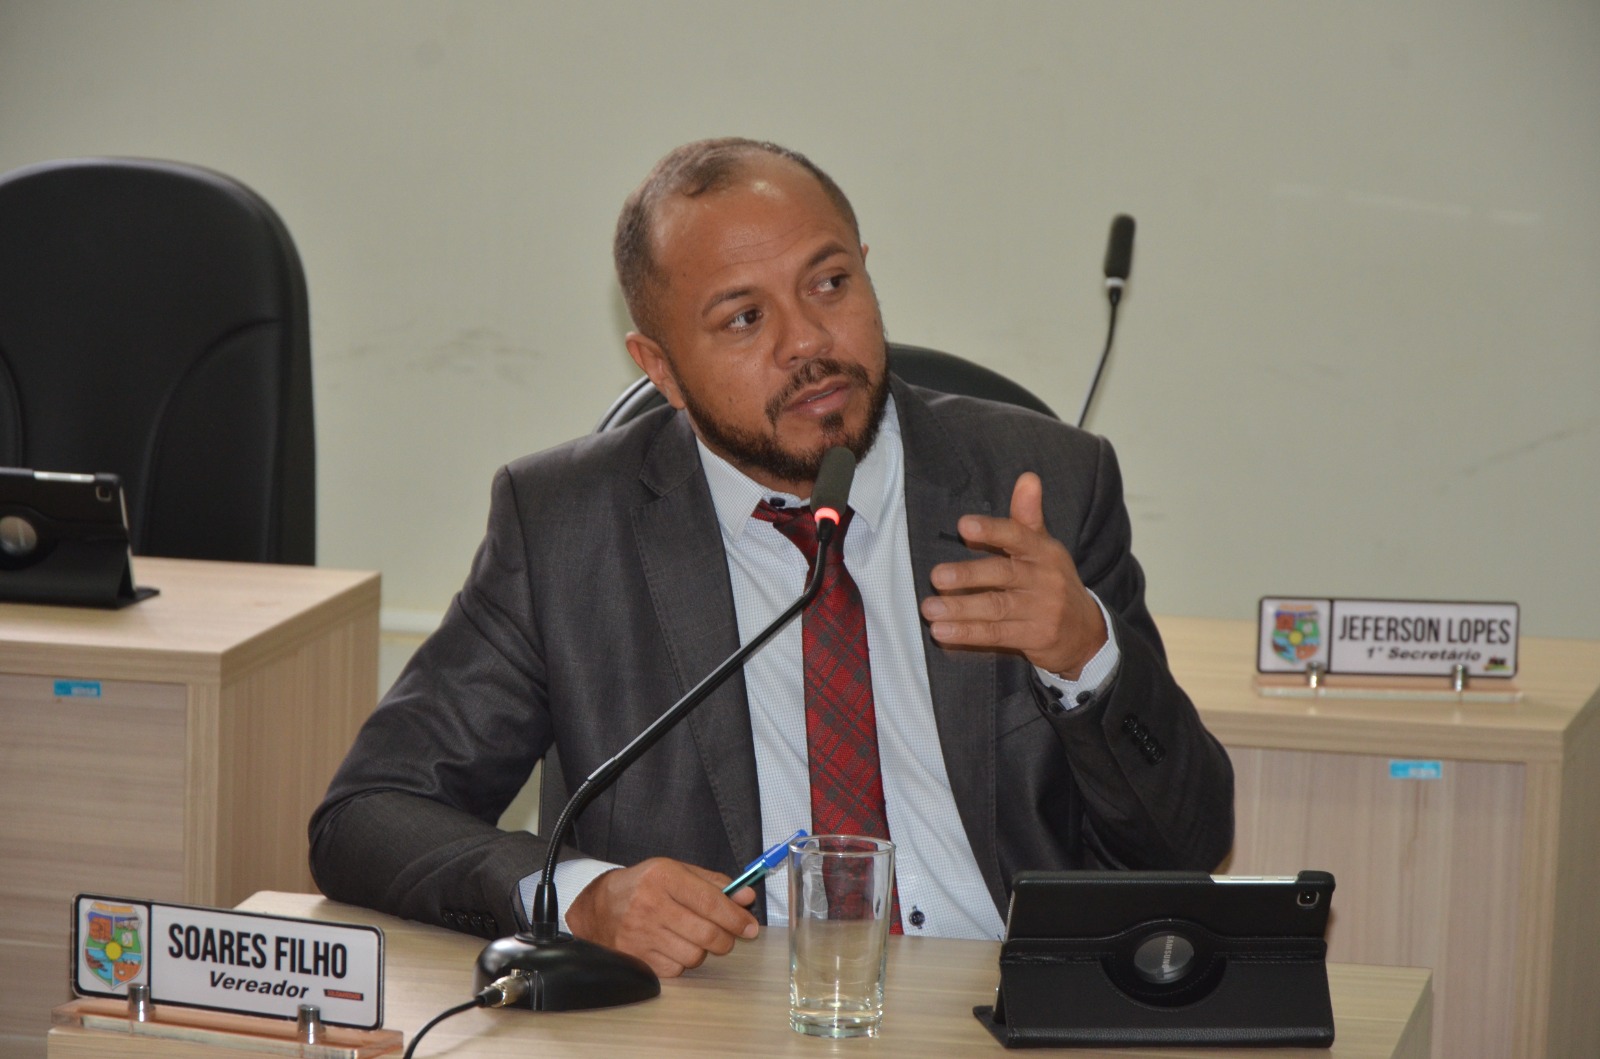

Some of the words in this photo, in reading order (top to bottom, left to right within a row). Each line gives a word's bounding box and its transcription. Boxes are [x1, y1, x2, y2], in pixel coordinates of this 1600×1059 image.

[1338, 615, 1441, 643] JEFERSON
[1447, 618, 1511, 645] LOPES
[1388, 646, 1482, 661] Secretário
[168, 923, 267, 969] SOARES
[274, 936, 348, 979] FILHO
[1161, 935, 1175, 969] SAMSUNG
[209, 970, 309, 999] Vereador
